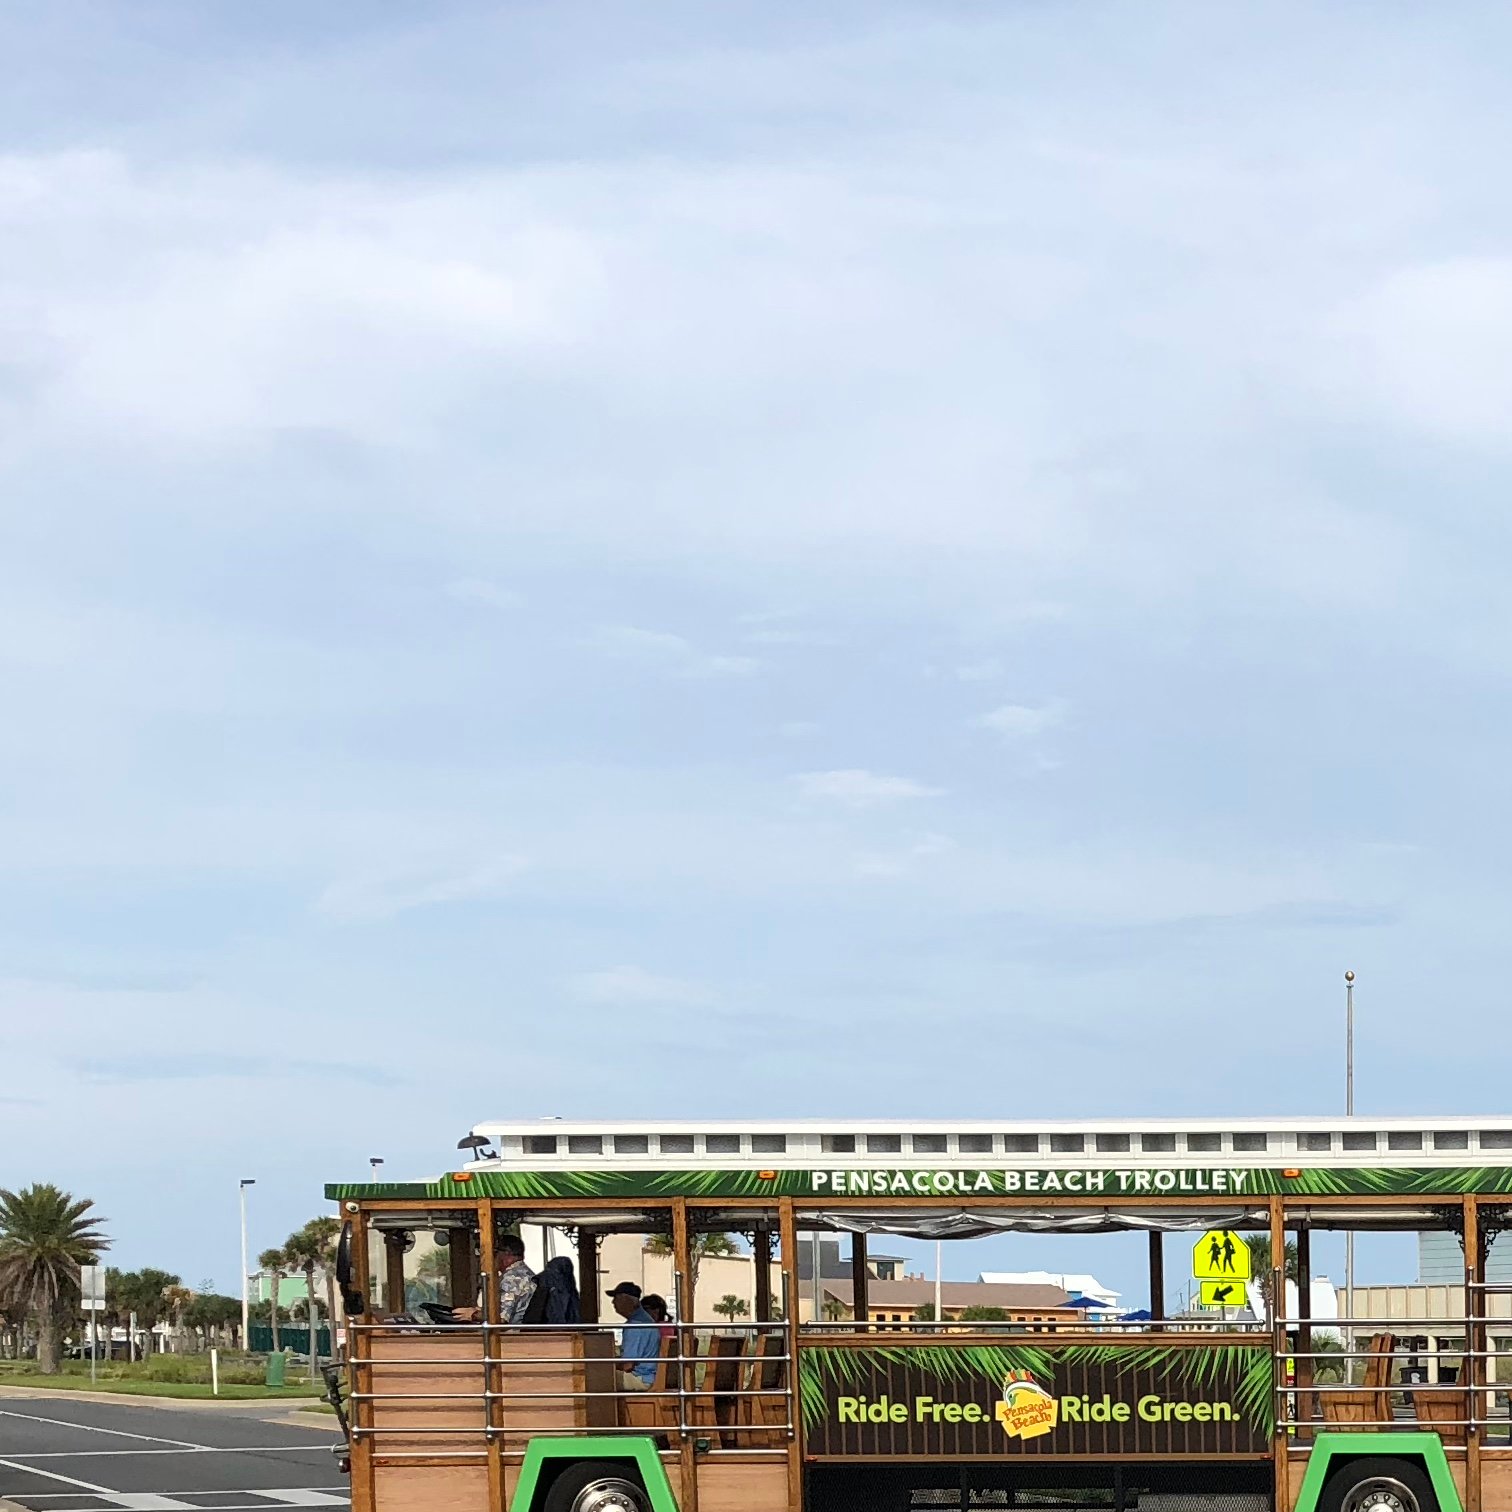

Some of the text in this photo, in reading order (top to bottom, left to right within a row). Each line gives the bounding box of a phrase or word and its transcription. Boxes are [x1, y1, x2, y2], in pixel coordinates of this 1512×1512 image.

[811, 1170, 1248, 1191] PENSACOLA BEACH TROLLEY
[837, 1395, 990, 1423] Ride Free.
[1002, 1399, 1053, 1421] Pensacola
[1061, 1394, 1241, 1422] Ride Green.
[1010, 1411, 1052, 1430] Beach
